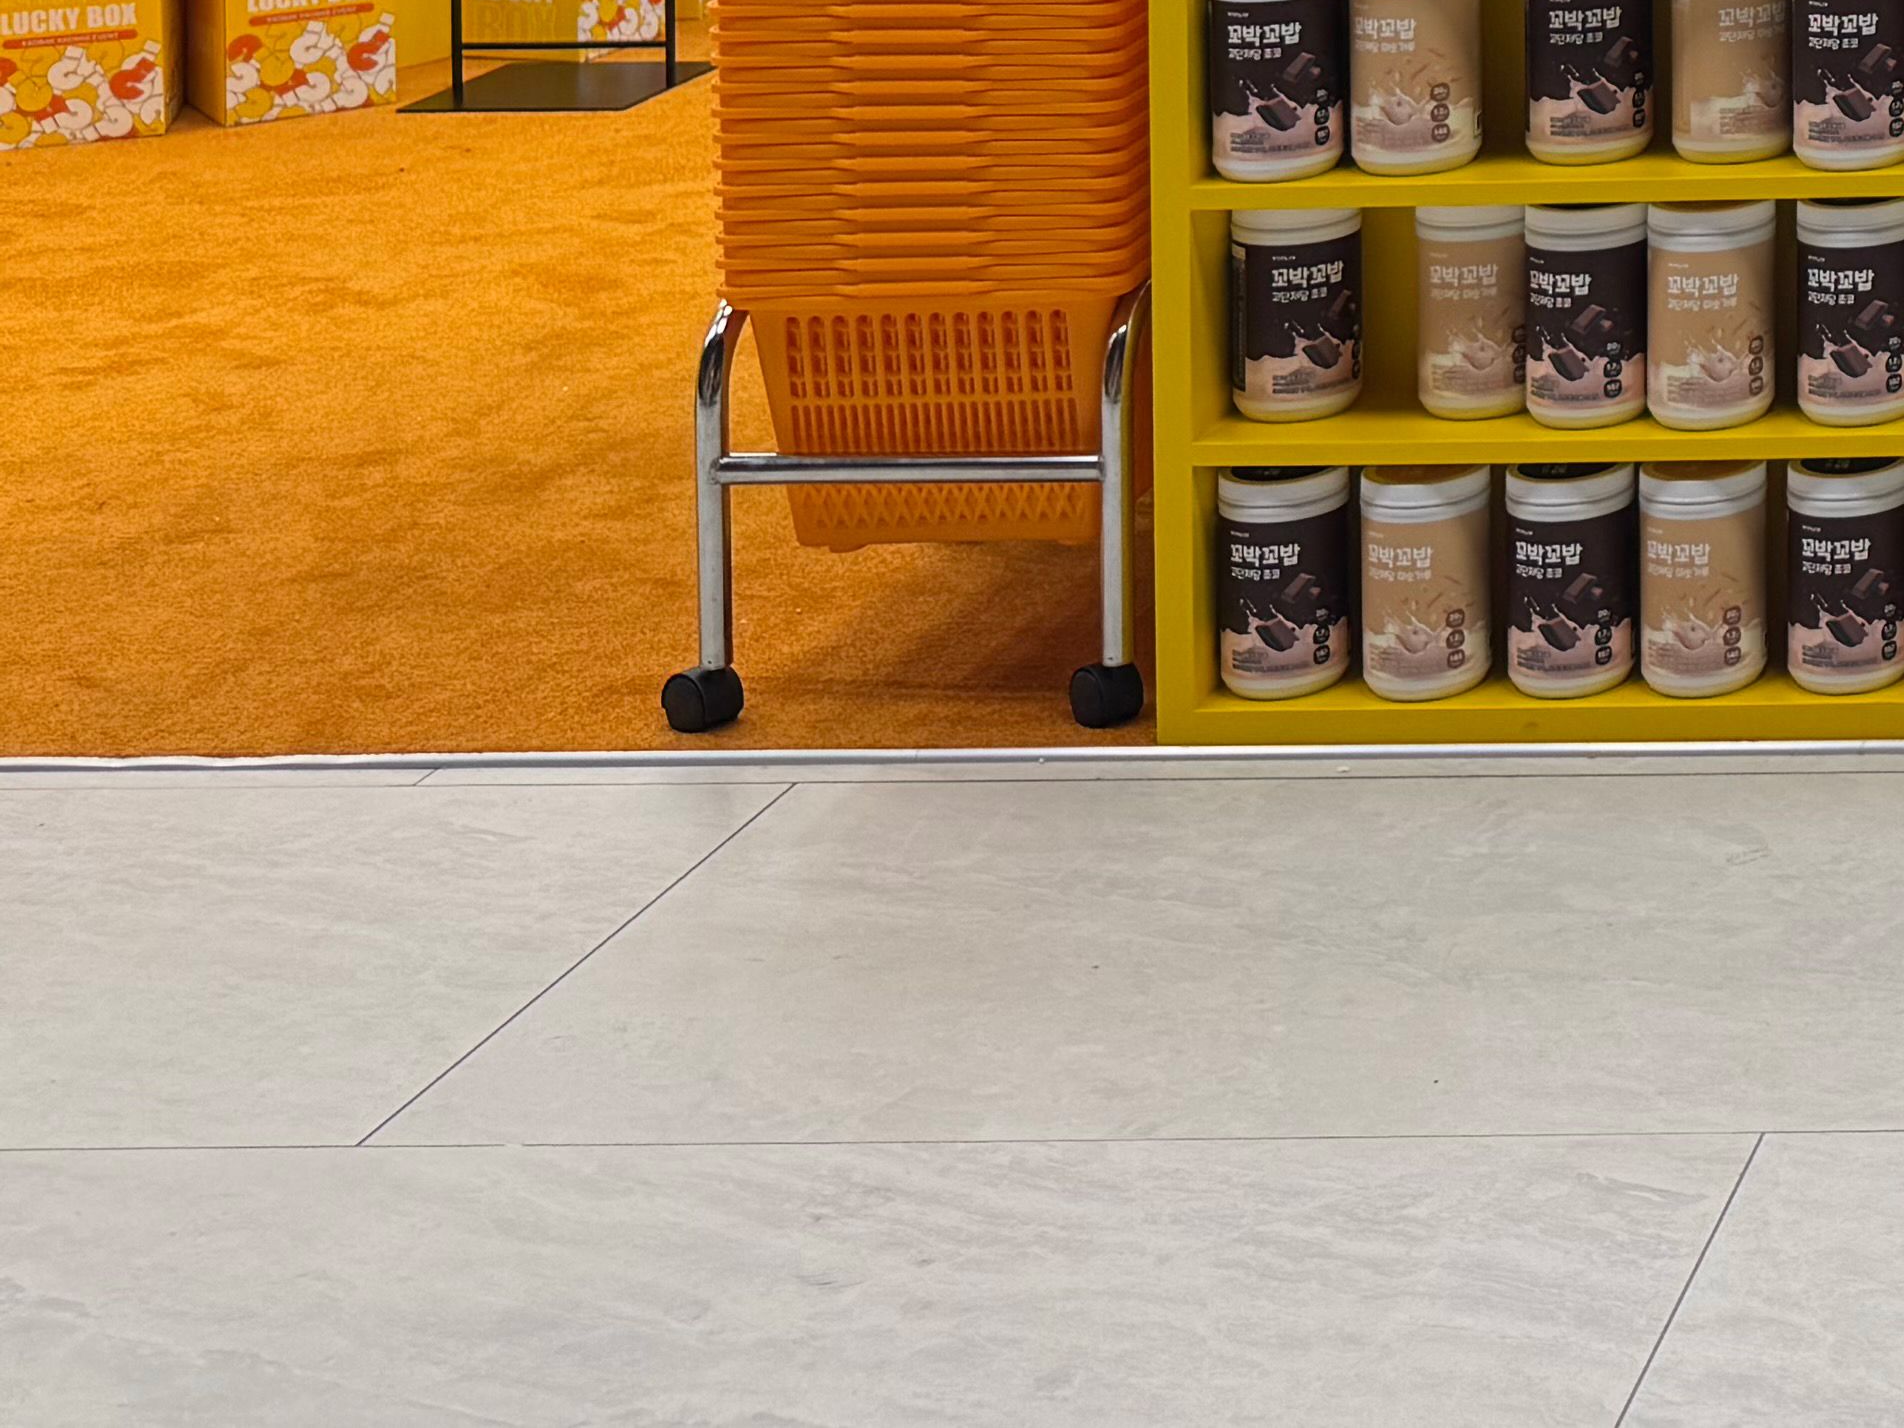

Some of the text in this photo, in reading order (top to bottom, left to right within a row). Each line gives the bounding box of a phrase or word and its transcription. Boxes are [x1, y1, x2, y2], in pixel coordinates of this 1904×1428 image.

[1, 2, 137, 36] LUCKY BOX
[1549, 6, 1622, 30] 꼬박꼬밥
[1668, 274, 1738, 297] 꼬박꼬밥
[1802, 538, 1870, 562] 꼬박꼬밥
